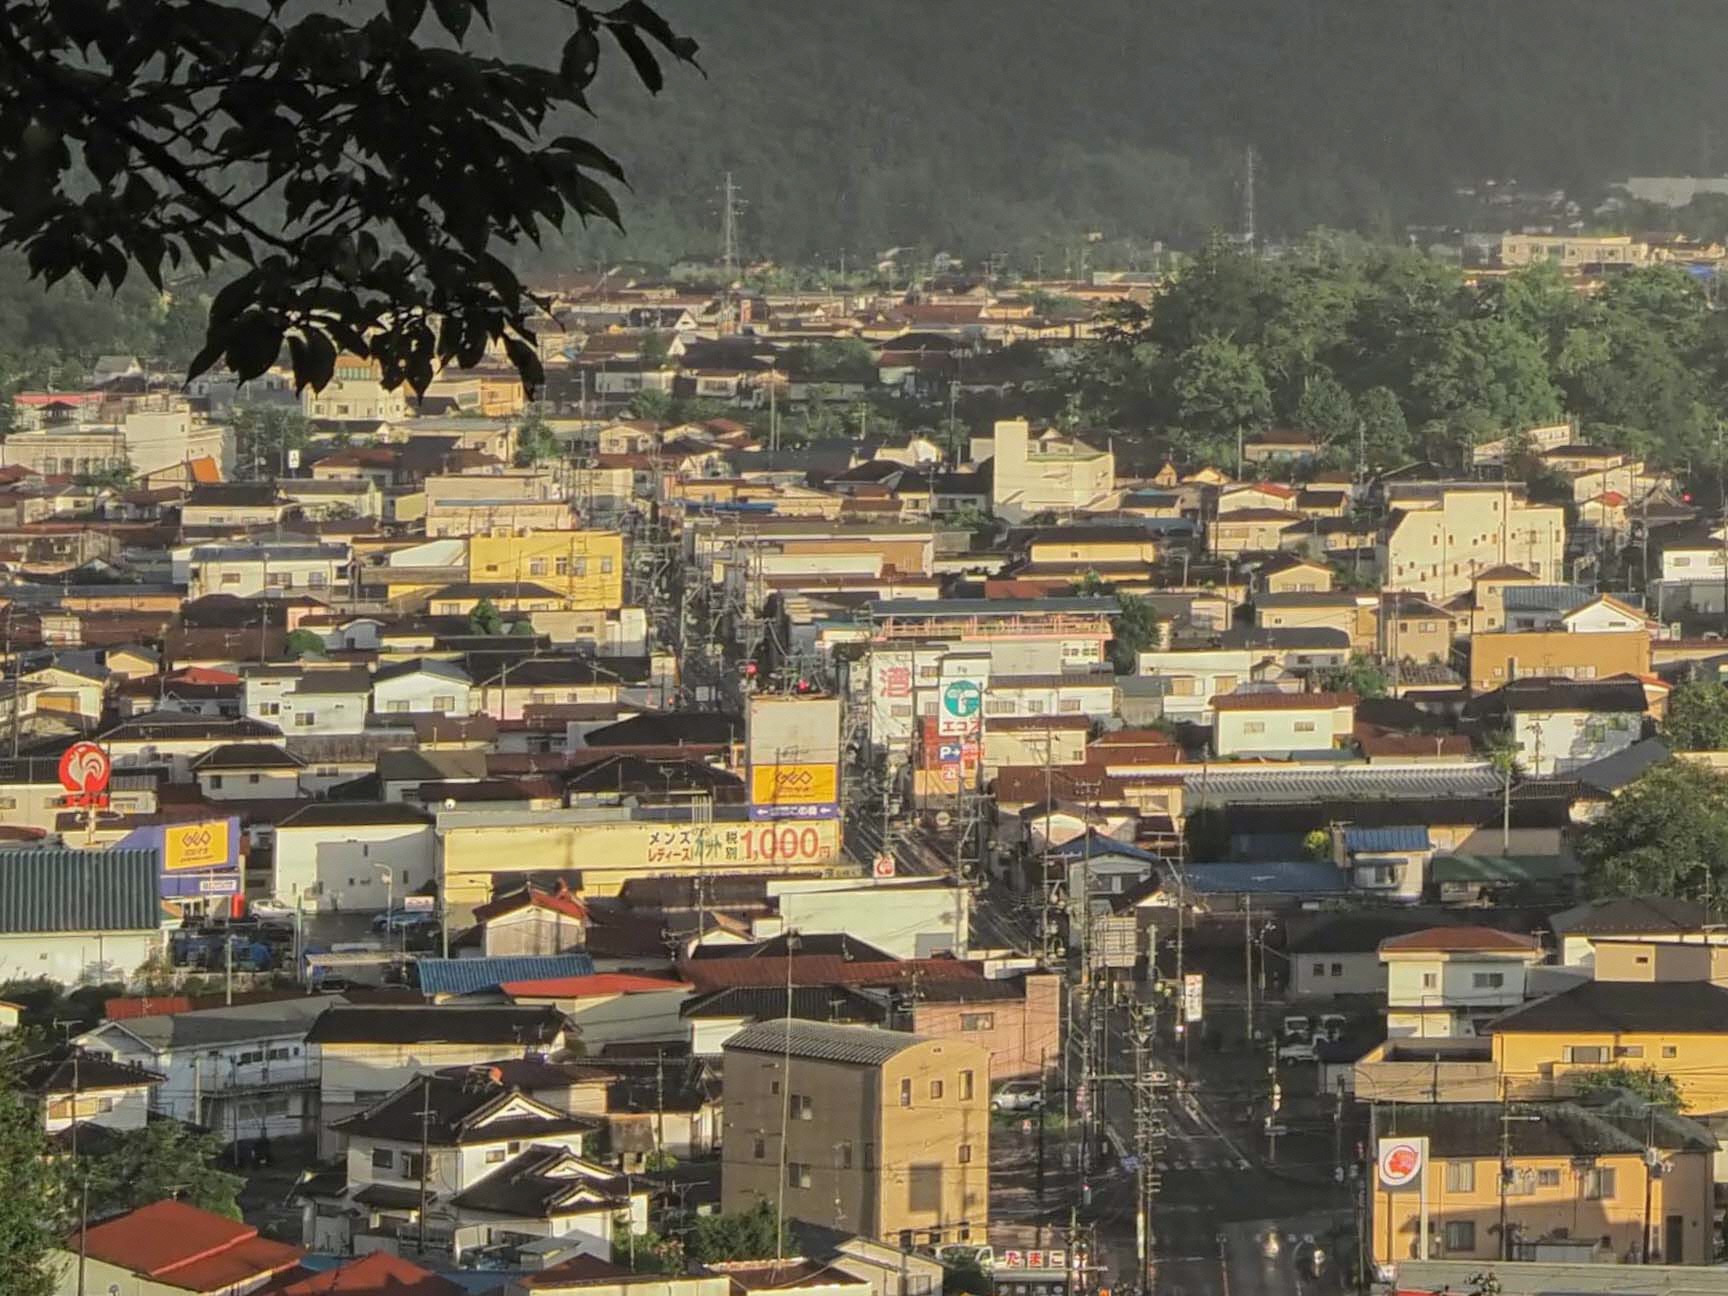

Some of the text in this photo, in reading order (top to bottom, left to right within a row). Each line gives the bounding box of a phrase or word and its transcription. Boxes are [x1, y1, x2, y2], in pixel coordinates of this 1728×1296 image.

[943, 720, 980, 733] エコス
[941, 746, 951, 759] P
[649, 829, 690, 845] メンズ
[648, 848, 691, 862] レディース
